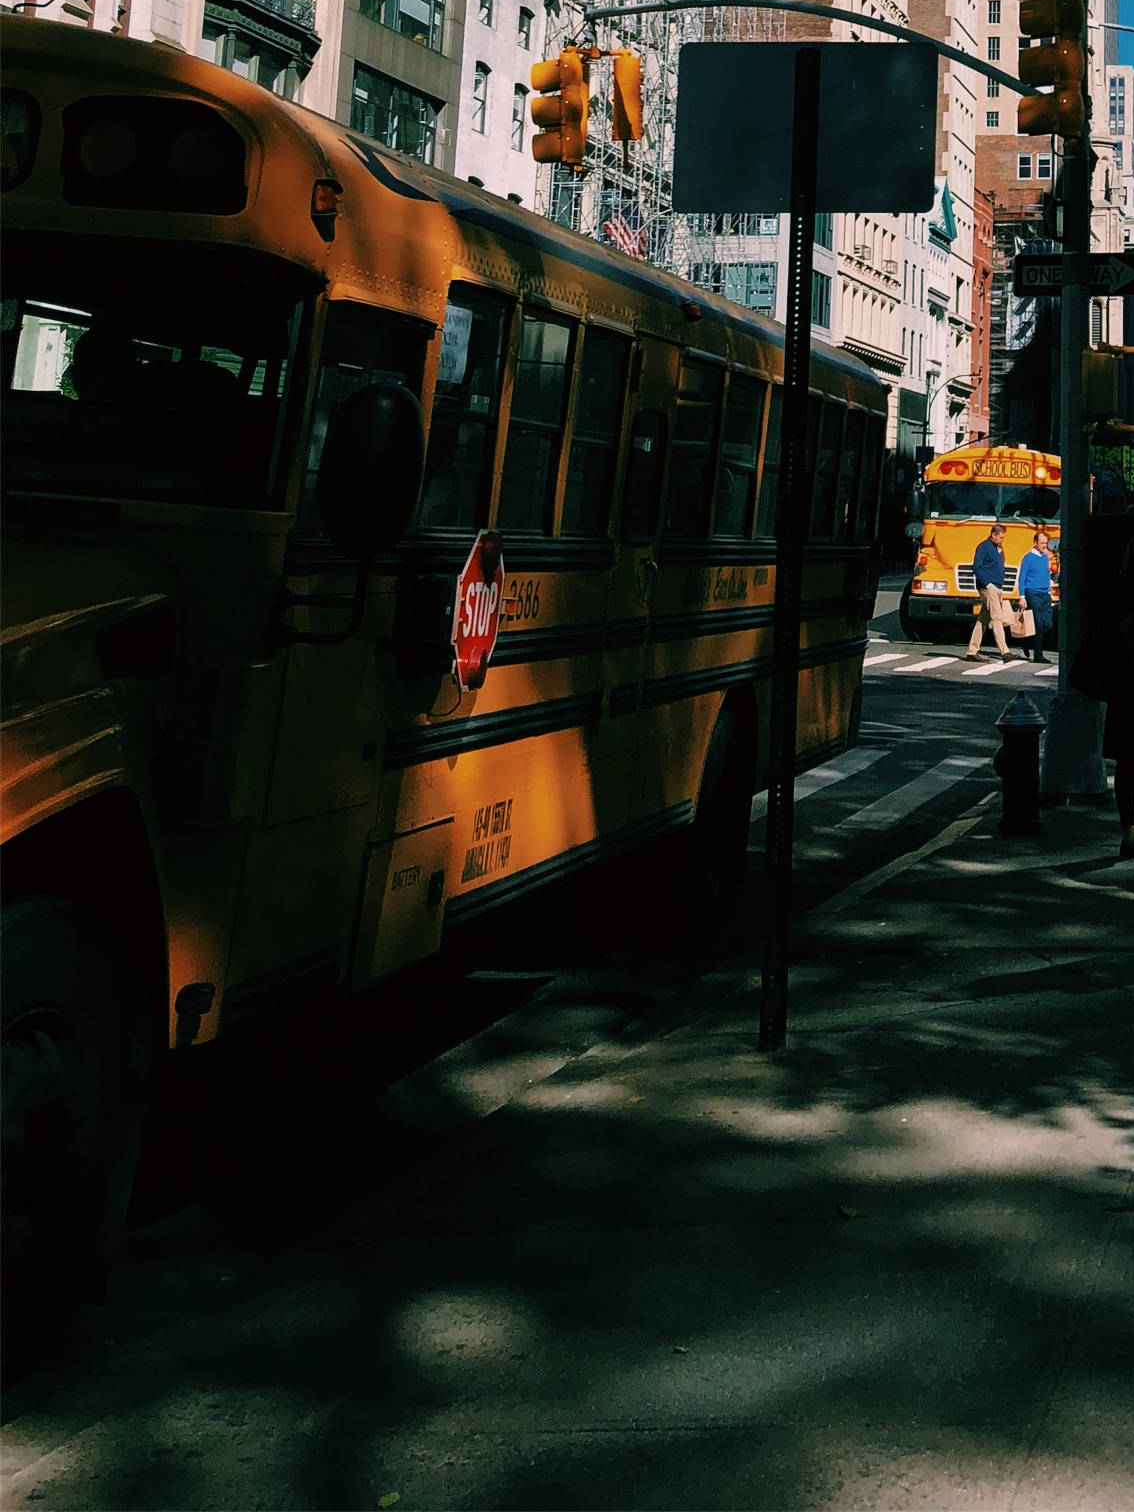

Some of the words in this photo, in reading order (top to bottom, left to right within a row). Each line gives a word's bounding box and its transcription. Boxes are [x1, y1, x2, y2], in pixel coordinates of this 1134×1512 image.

[1026, 268, 1062, 284] ONE
[974, 459, 1007, 477] SCHOOL
[1010, 461, 1029, 477] BUS
[463, 581, 498, 638] STOP
